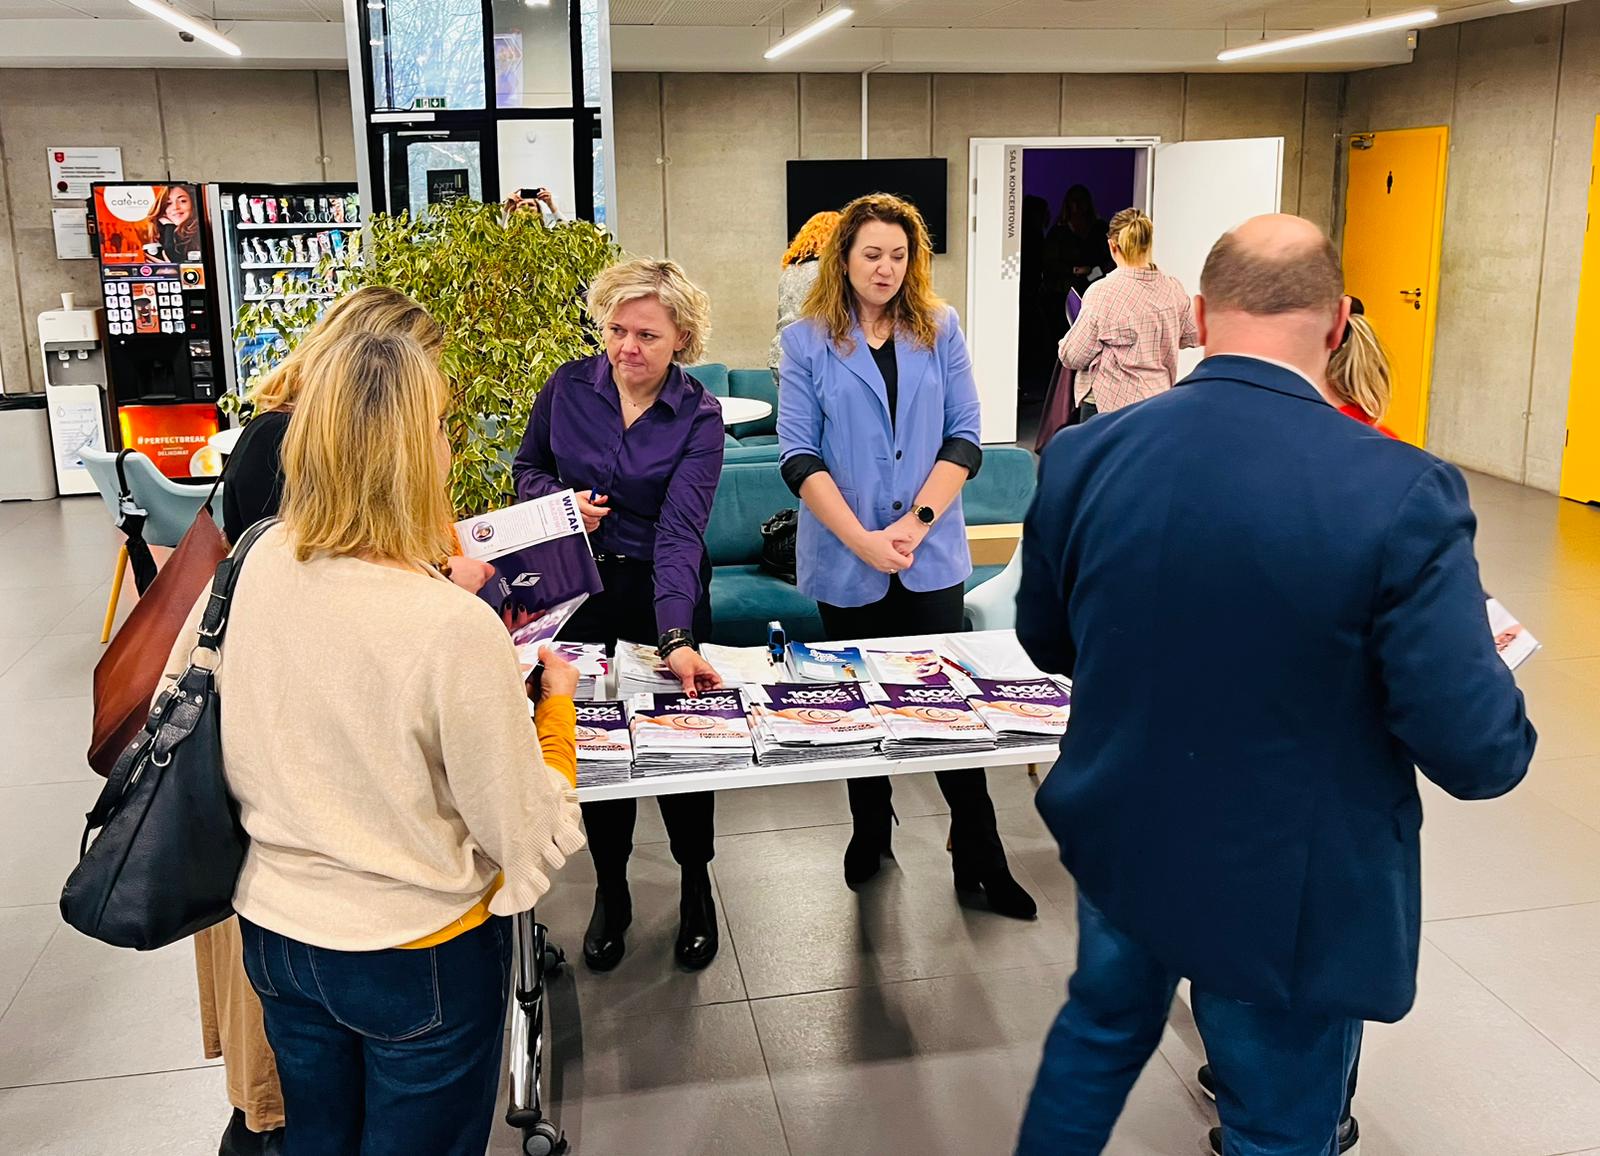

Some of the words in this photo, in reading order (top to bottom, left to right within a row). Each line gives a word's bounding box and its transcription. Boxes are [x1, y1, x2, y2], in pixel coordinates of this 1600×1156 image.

[1008, 175, 1016, 238] KONCERTOWA
[137, 435, 206, 445] #PERFECTBREAK
[788, 688, 848, 699] 100%
[676, 695, 737, 706] 100%
